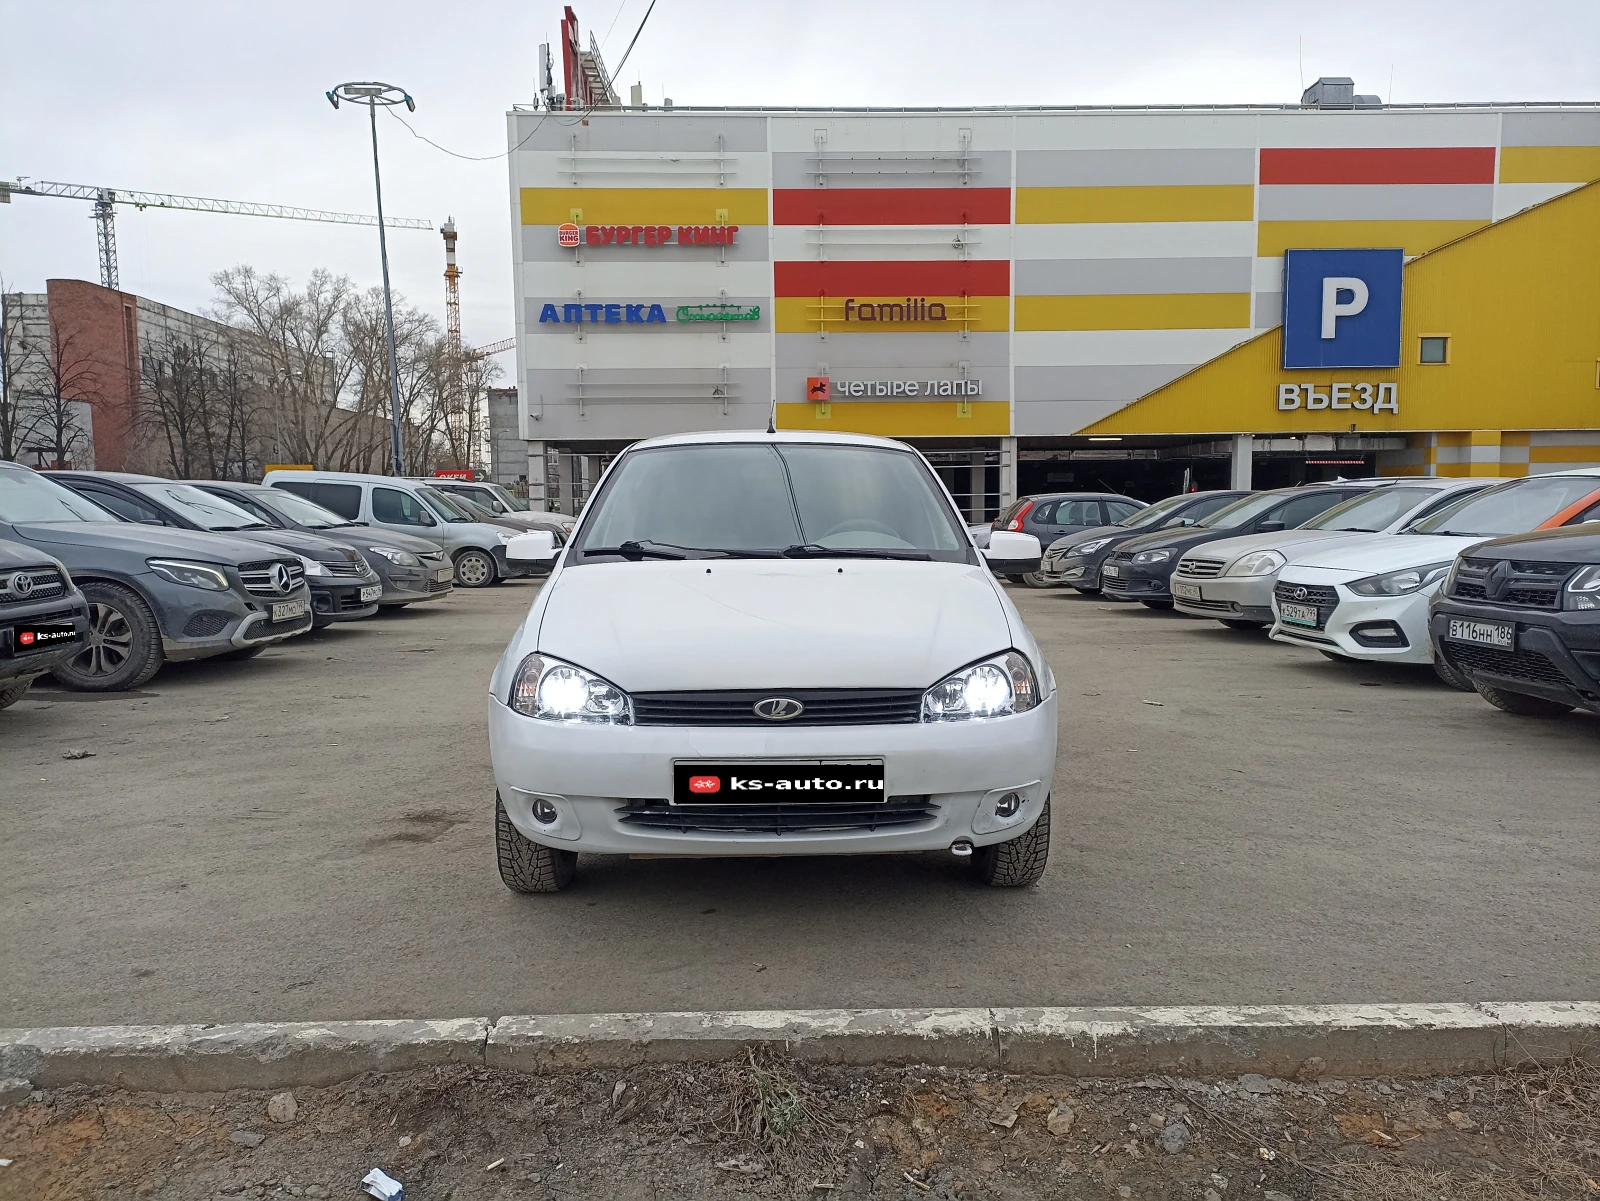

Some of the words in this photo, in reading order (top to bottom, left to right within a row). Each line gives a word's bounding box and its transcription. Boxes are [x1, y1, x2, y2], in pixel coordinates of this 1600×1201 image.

[585, 225, 673, 246] БУРГЕР
[677, 225, 739, 246] КИНГ
[539, 303, 667, 324] АПТЕКА
[844, 297, 947, 321] familia
[925, 380, 982, 396] лапы
[1278, 382, 1399, 415] ВЪЕЗД
[1451, 622, 1493, 642] В116НН
[1495, 625, 1512, 640] 186
